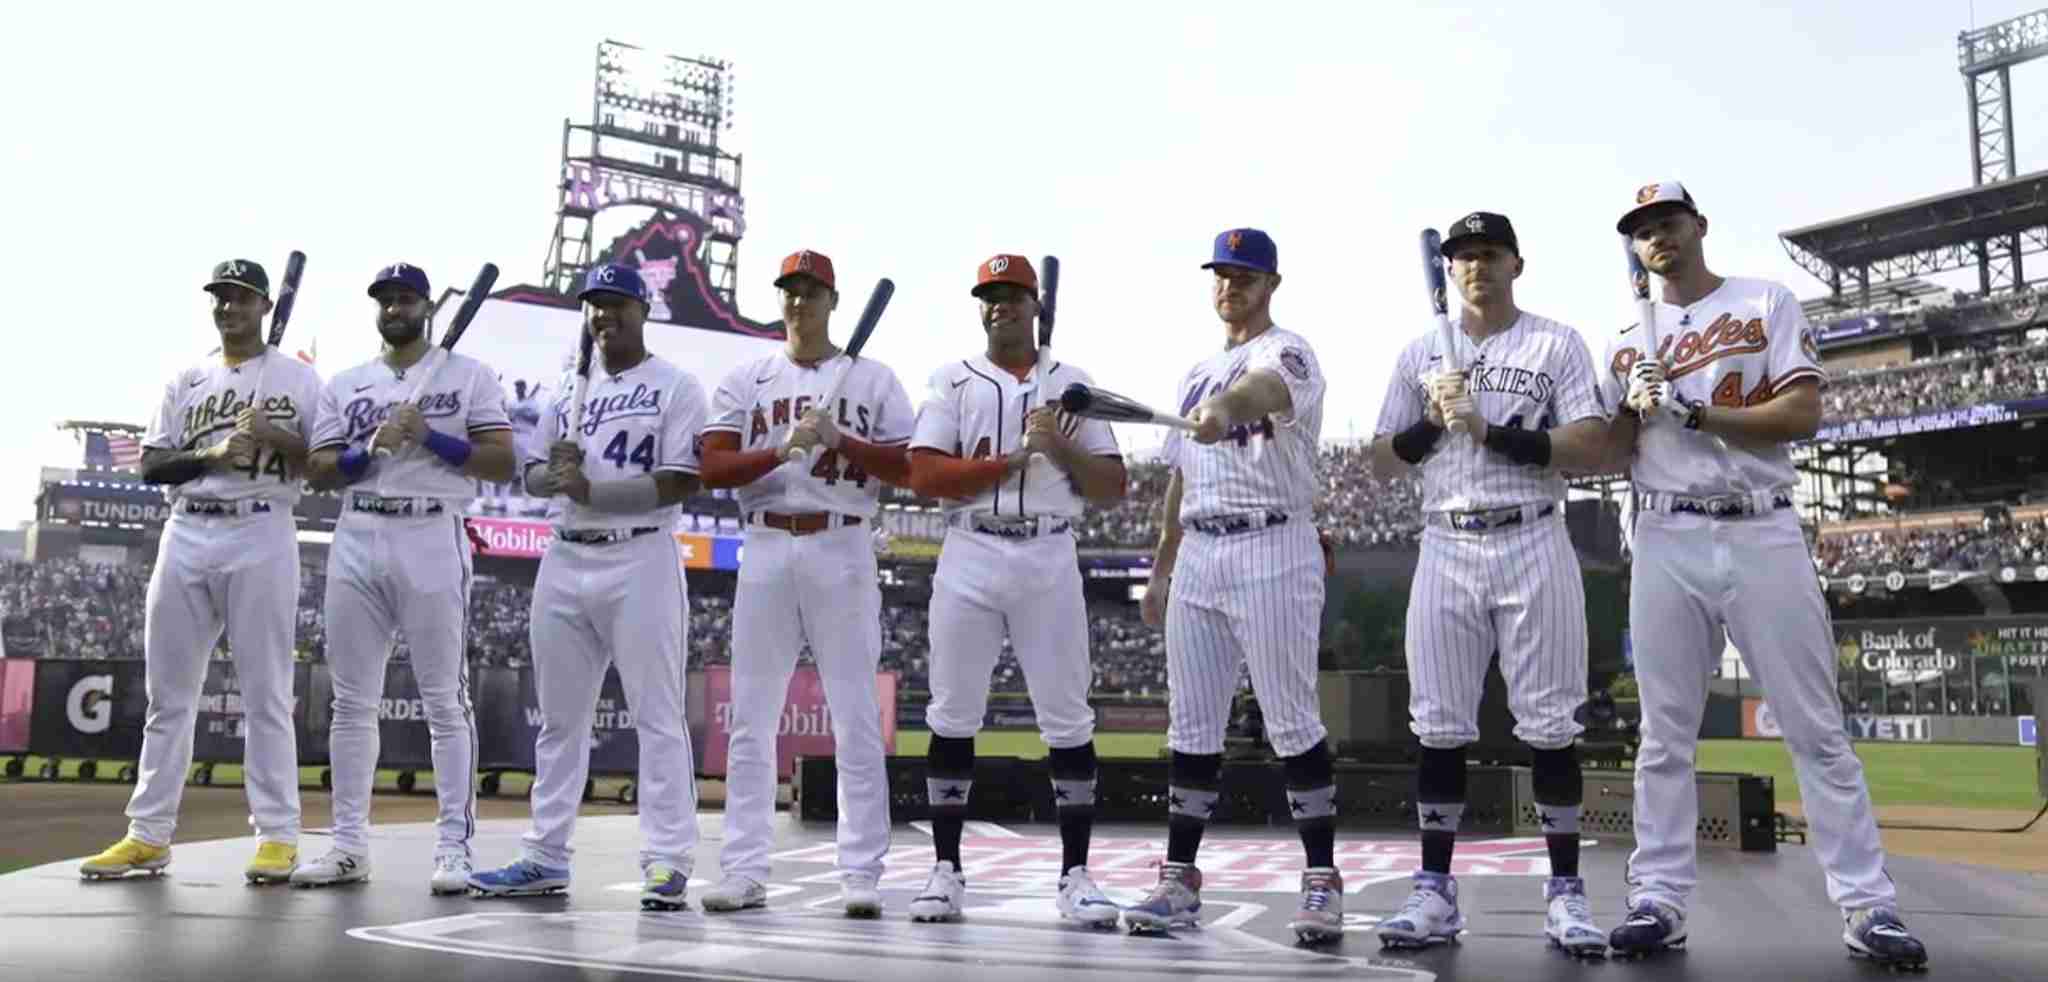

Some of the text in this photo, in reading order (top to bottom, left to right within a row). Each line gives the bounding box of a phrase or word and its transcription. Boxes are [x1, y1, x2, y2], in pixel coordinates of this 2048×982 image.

[391, 263, 408, 278] T
[597, 265, 614, 283] KC
[1611, 311, 1768, 382] Oioles
[344, 390, 462, 440] Raers
[554, 383, 662, 439] Ryals
[750, 395, 870, 446] ANGLS
[602, 430, 655, 472] 44
[82, 501, 170, 520] TUNDRA
[1861, 626, 1936, 650] Bank of
[1861, 648, 1956, 671] Colorado
[66, 674, 114, 733] G
[1856, 715, 1924, 741] YETI
